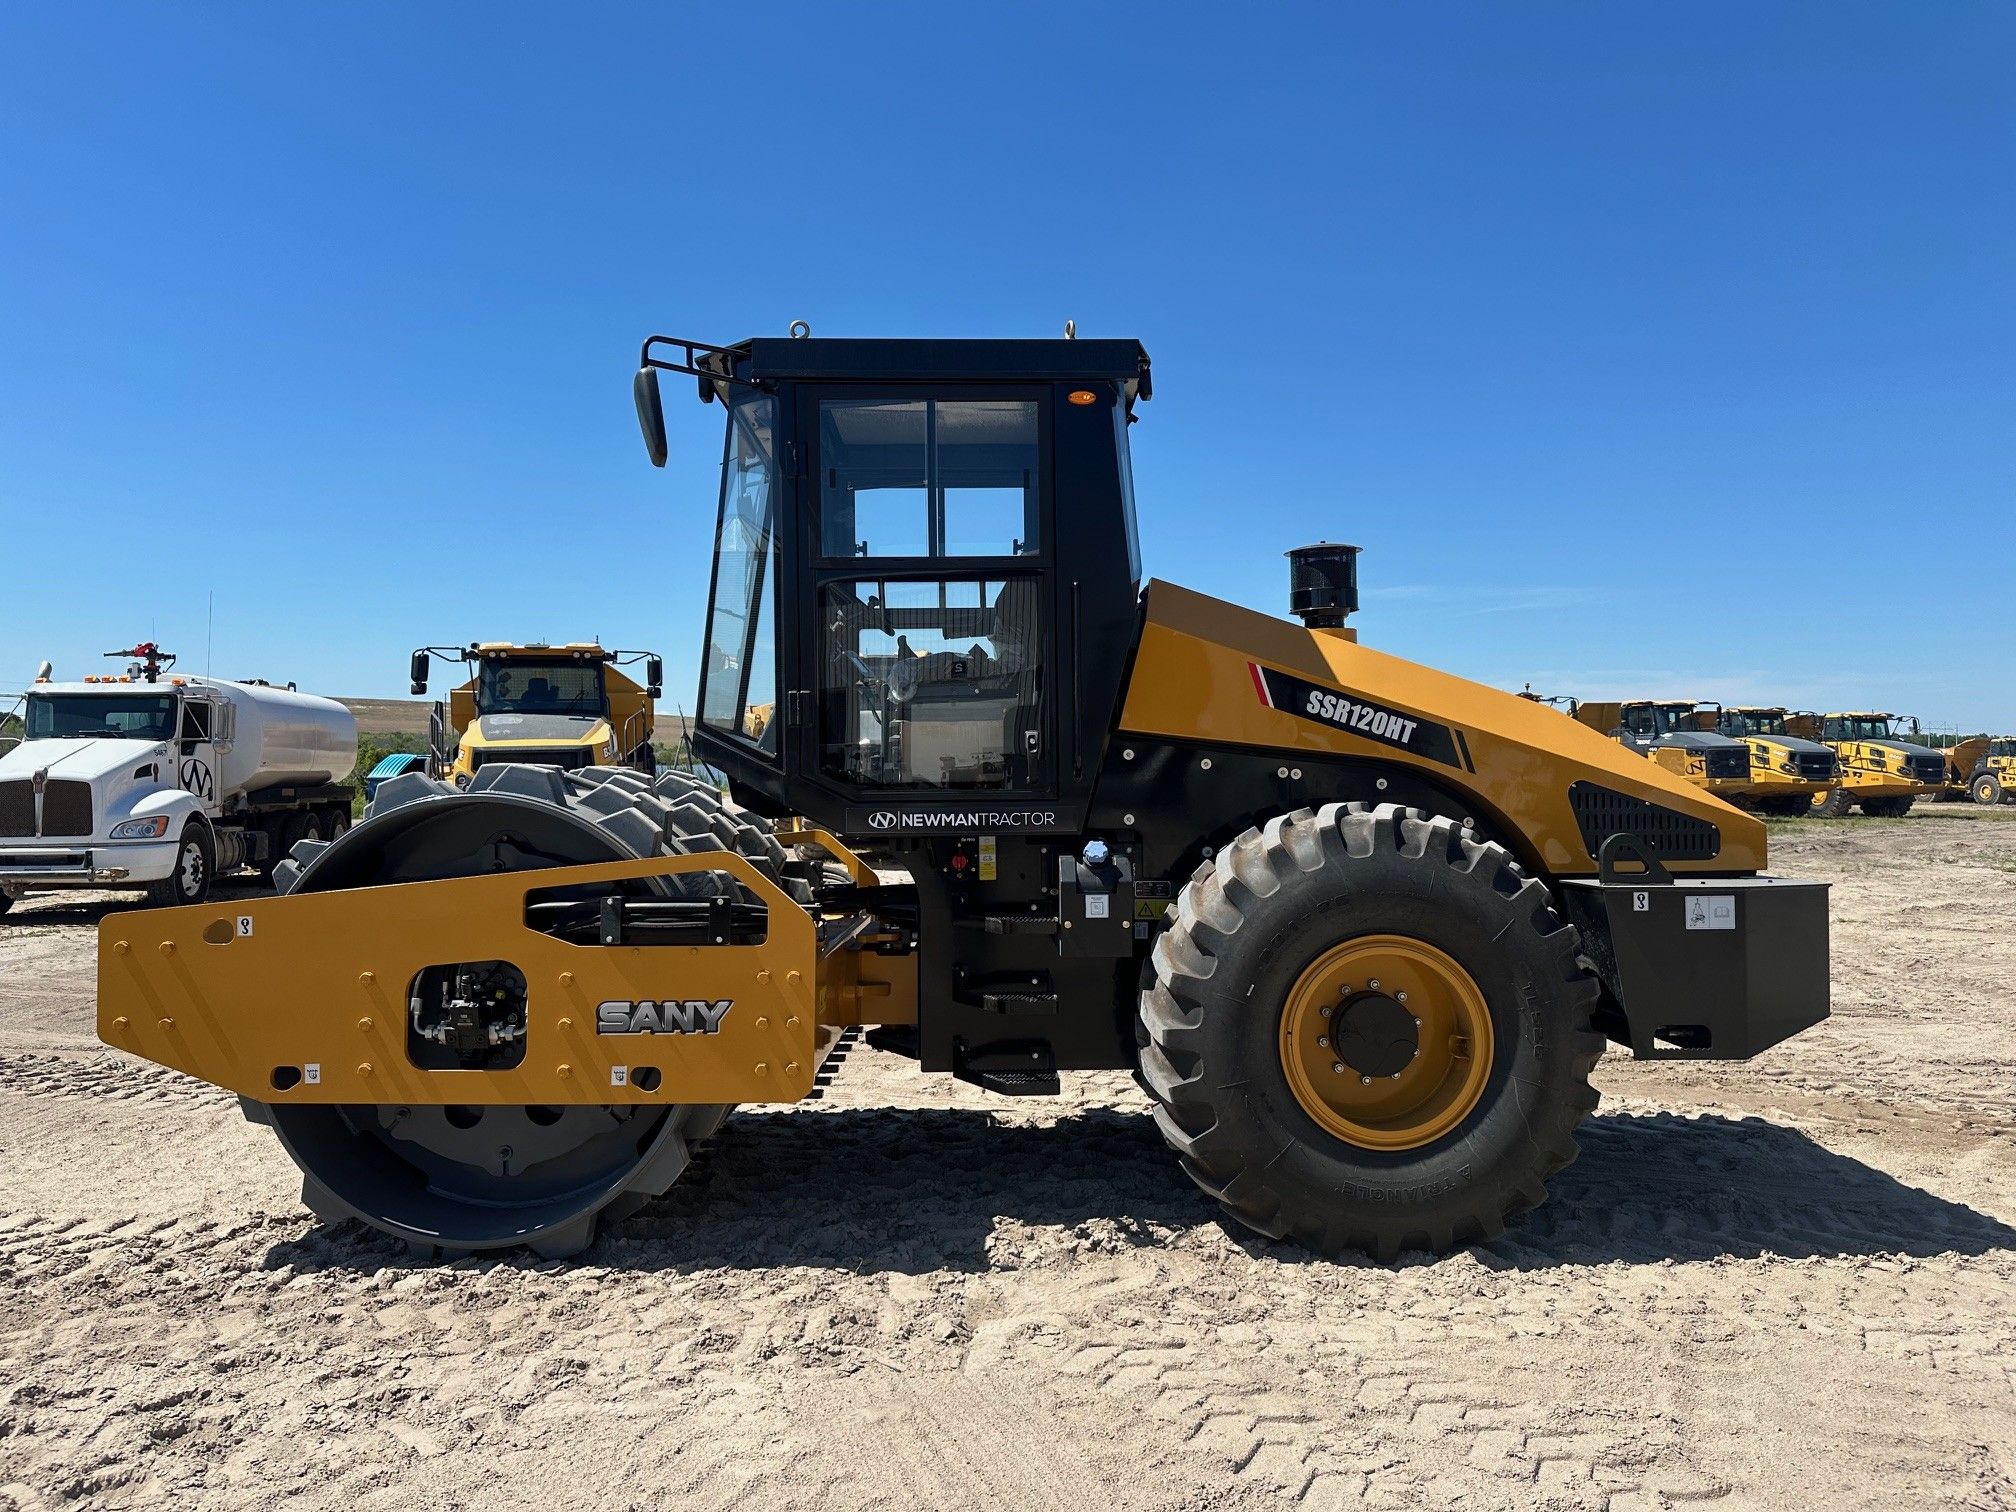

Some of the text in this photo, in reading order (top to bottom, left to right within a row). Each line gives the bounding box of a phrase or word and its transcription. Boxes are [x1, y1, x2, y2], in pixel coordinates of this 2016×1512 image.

[1306, 690, 1418, 744] SSR120HT
[902, 812, 1056, 827] NEWMANTRACTOR
[597, 1000, 733, 1034] SANY
[1341, 1176, 1458, 1203] TRIANGLE
